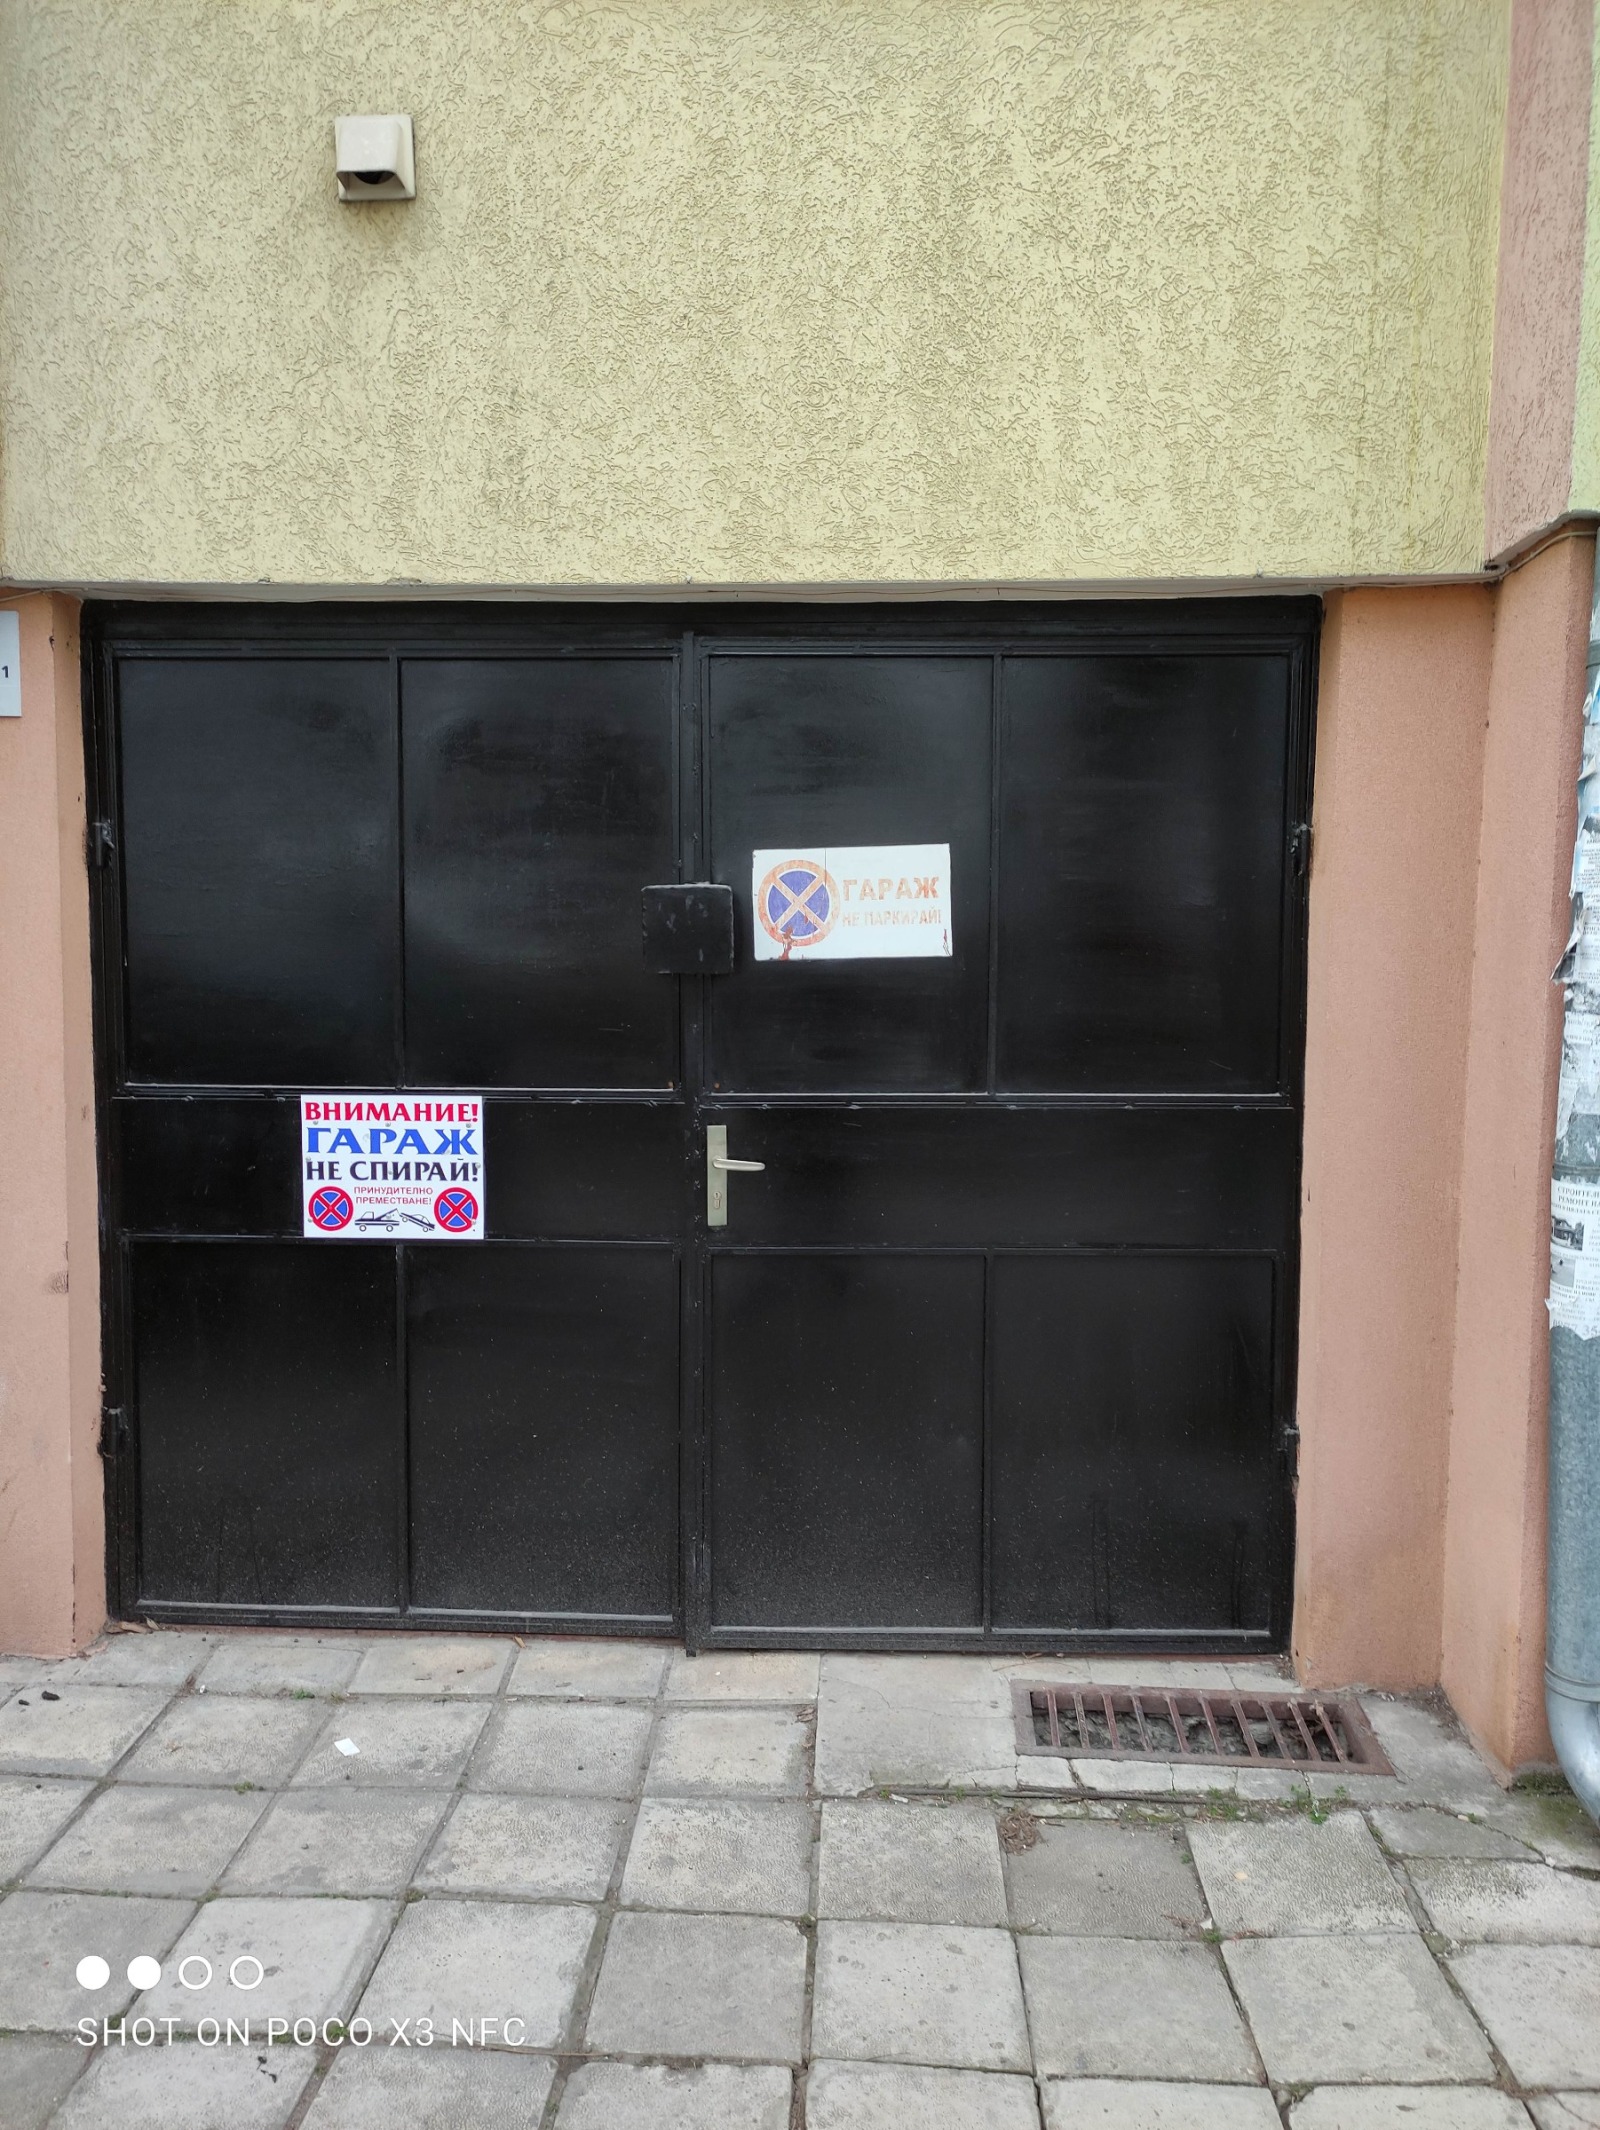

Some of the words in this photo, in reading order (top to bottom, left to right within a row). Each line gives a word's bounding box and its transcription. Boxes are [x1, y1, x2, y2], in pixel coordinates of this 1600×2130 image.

[843, 876, 940, 901] ГАРАЖ
[842, 911, 860, 927] НЕ
[305, 1102, 478, 1122] ВНИМАНИЕ!
[307, 1127, 478, 1155] ГАРАЖ
[306, 1160, 342, 1181] НЕ
[350, 1158, 478, 1182] СПИРАЙ!
[353, 1186, 433, 1196] ПРИНУДИТЕЛНО
[356, 1196, 432, 1205] ПРЕМЕСТВАНЕ!
